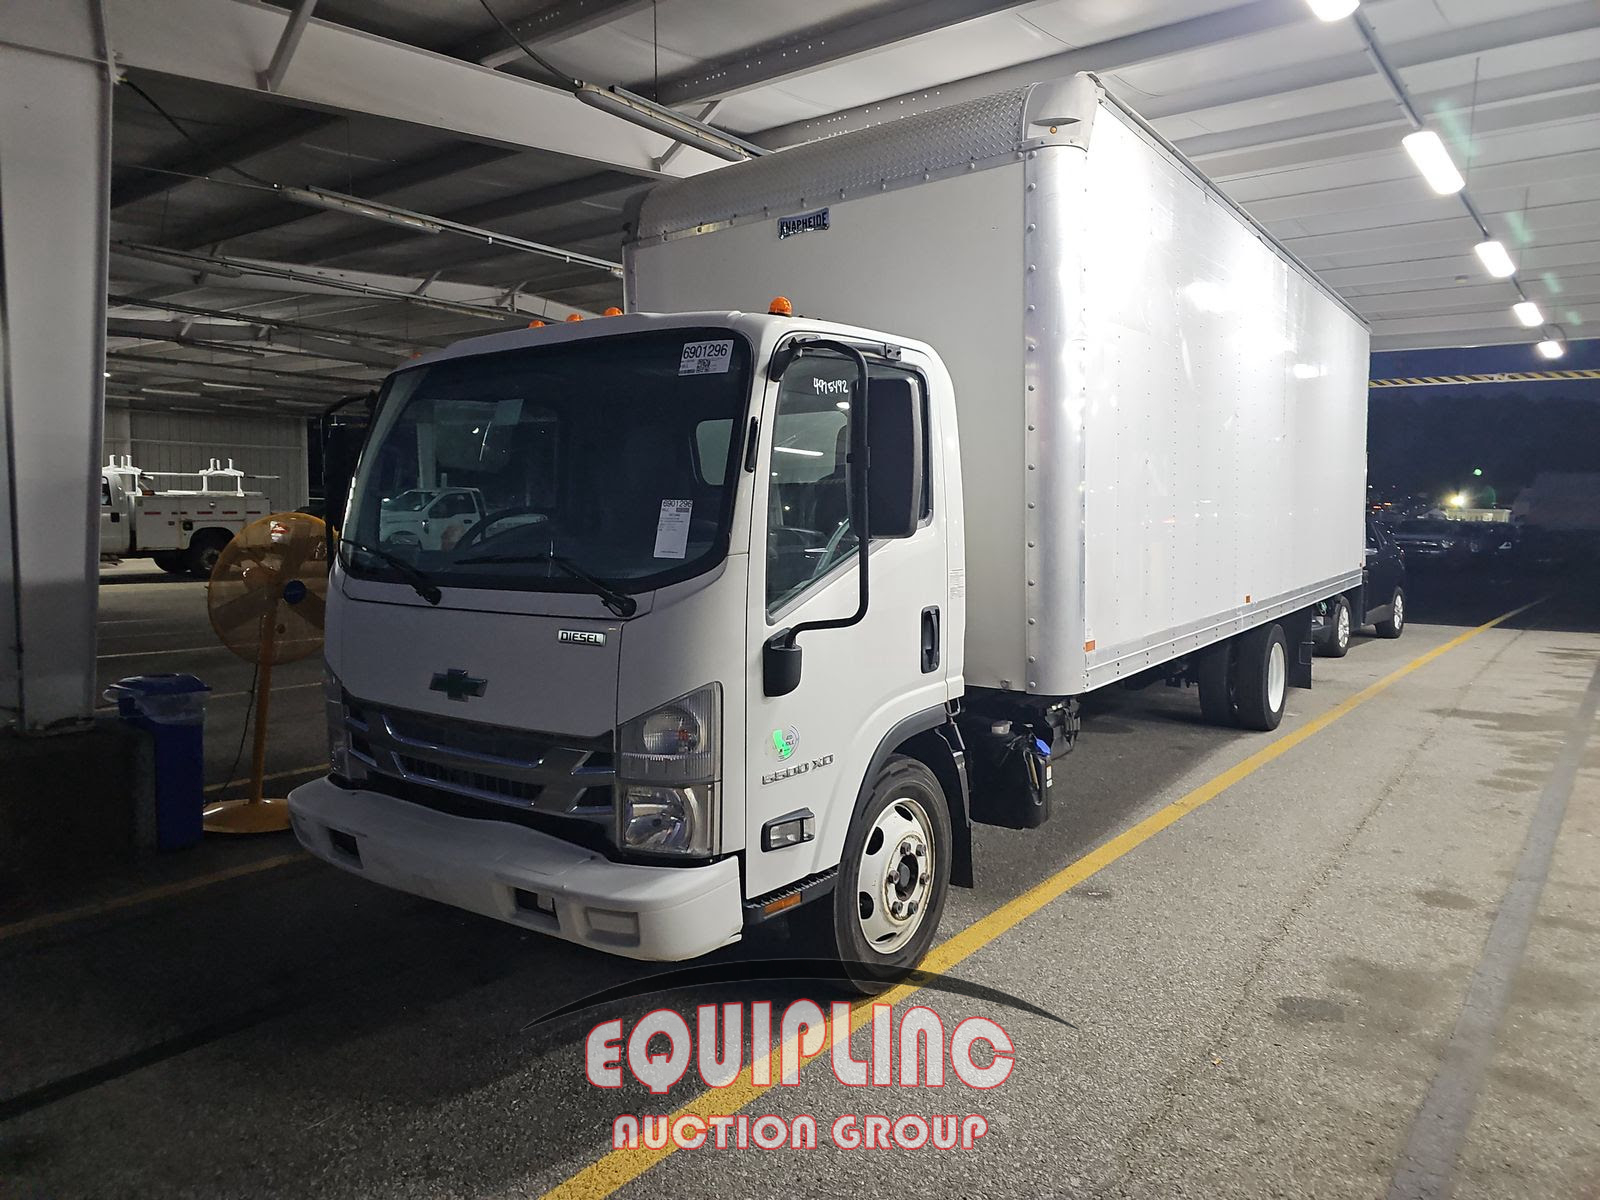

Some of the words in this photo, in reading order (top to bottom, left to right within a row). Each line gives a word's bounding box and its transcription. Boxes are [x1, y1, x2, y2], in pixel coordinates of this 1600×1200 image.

[779, 211, 827, 235] KNAPHEIDE
[683, 343, 729, 359] 6901296
[560, 631, 601, 644] DIESEL
[762, 762, 809, 785] 5500
[812, 754, 834, 770] XD
